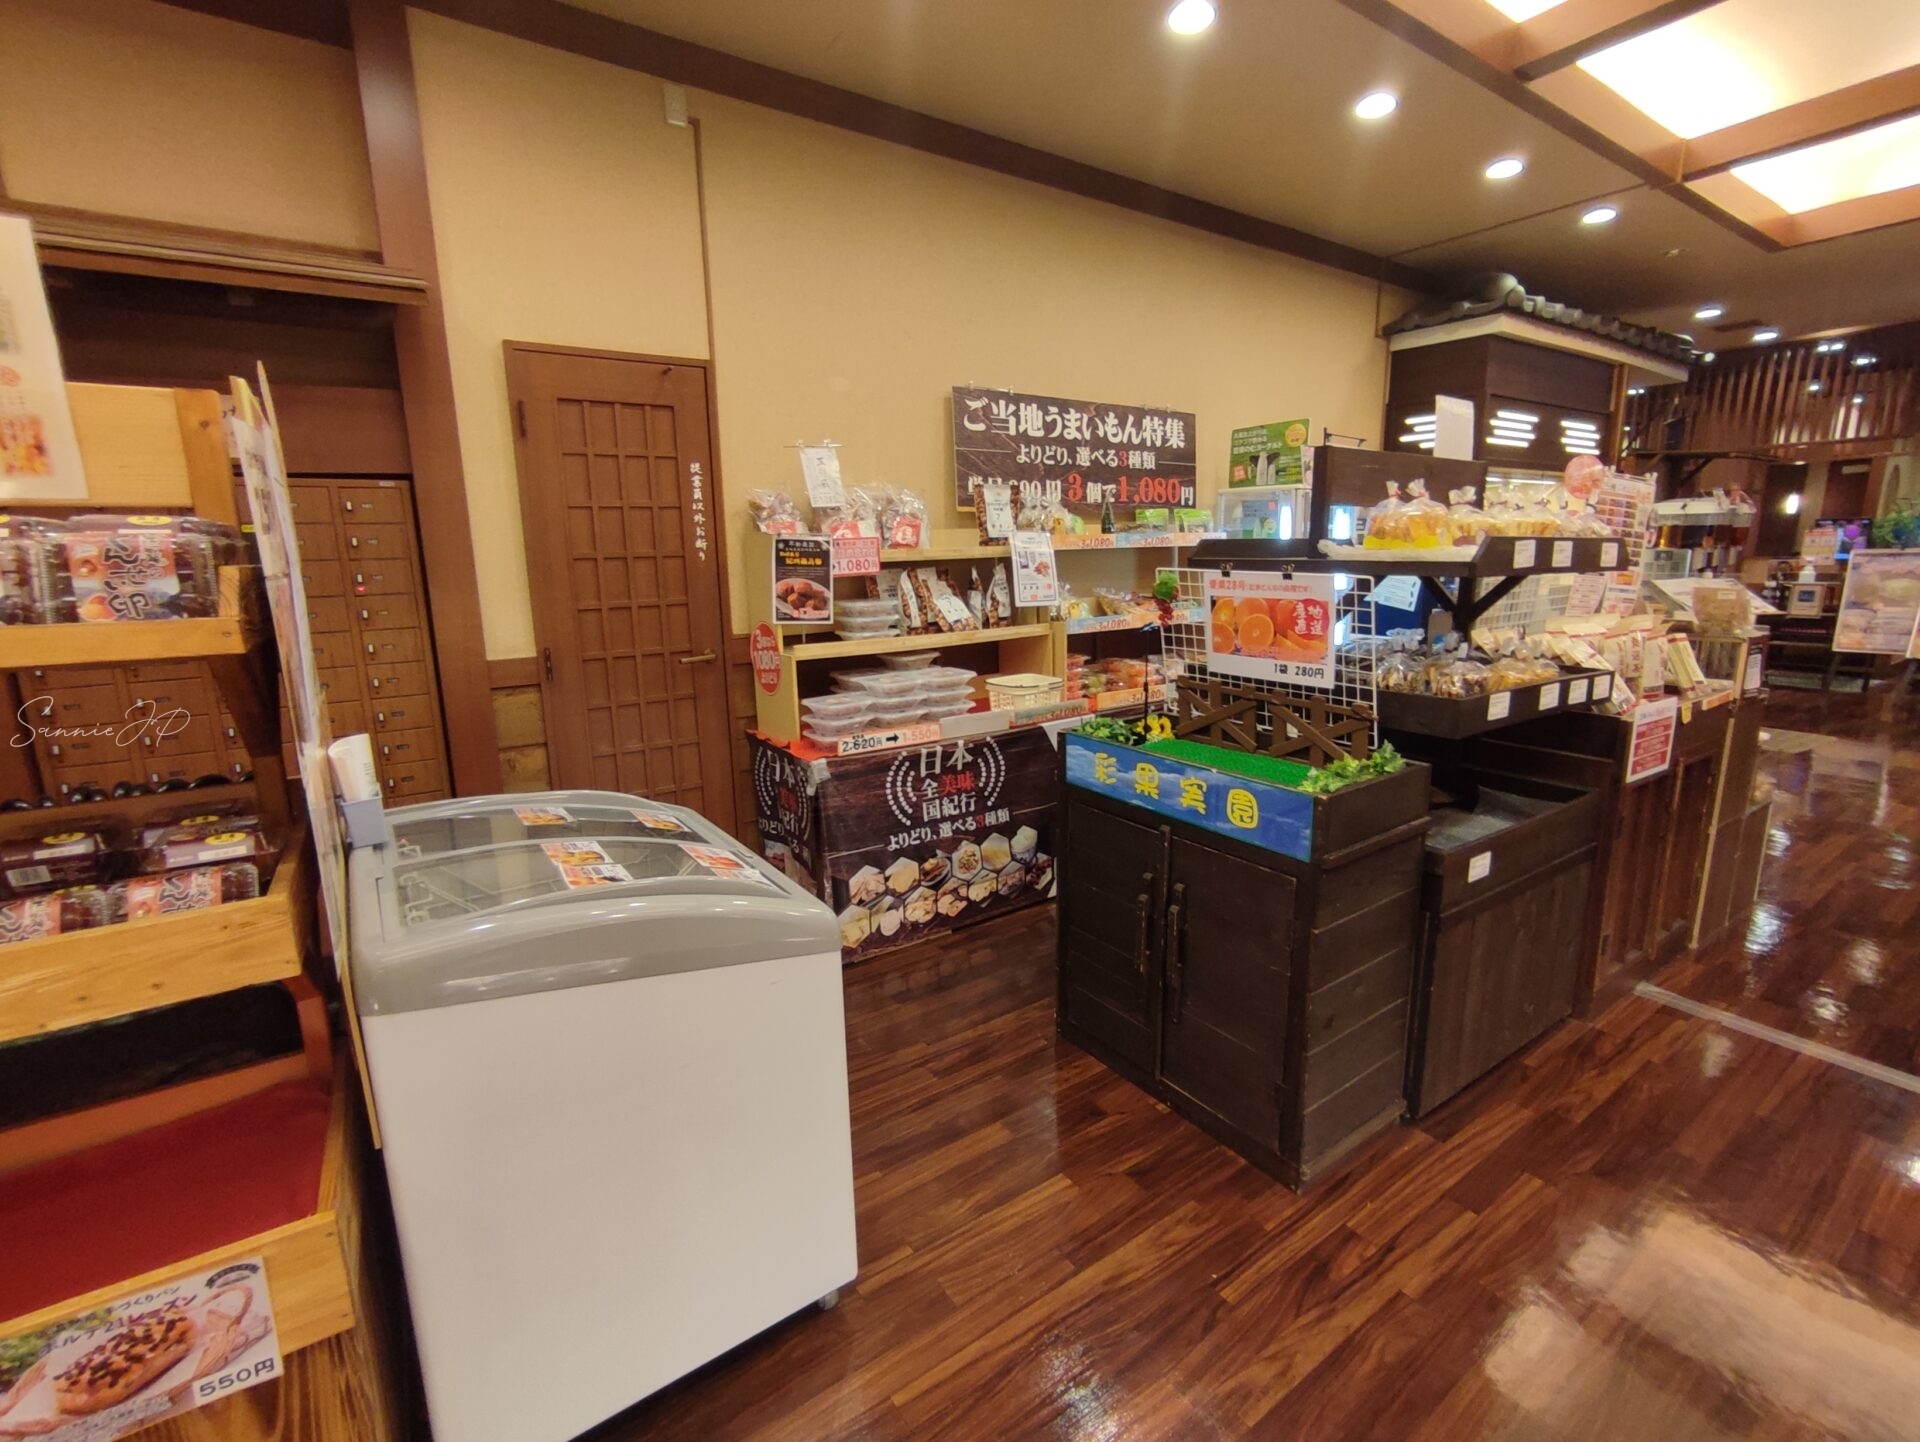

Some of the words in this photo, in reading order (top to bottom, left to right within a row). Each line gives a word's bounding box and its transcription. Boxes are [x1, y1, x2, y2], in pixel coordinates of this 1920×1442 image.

[963, 396, 1186, 449] ご当地うまいもん特集
[1294, 666, 1325, 679] 280円
[920, 739, 974, 778] 日本
[199, 1357, 275, 1398] 550円
